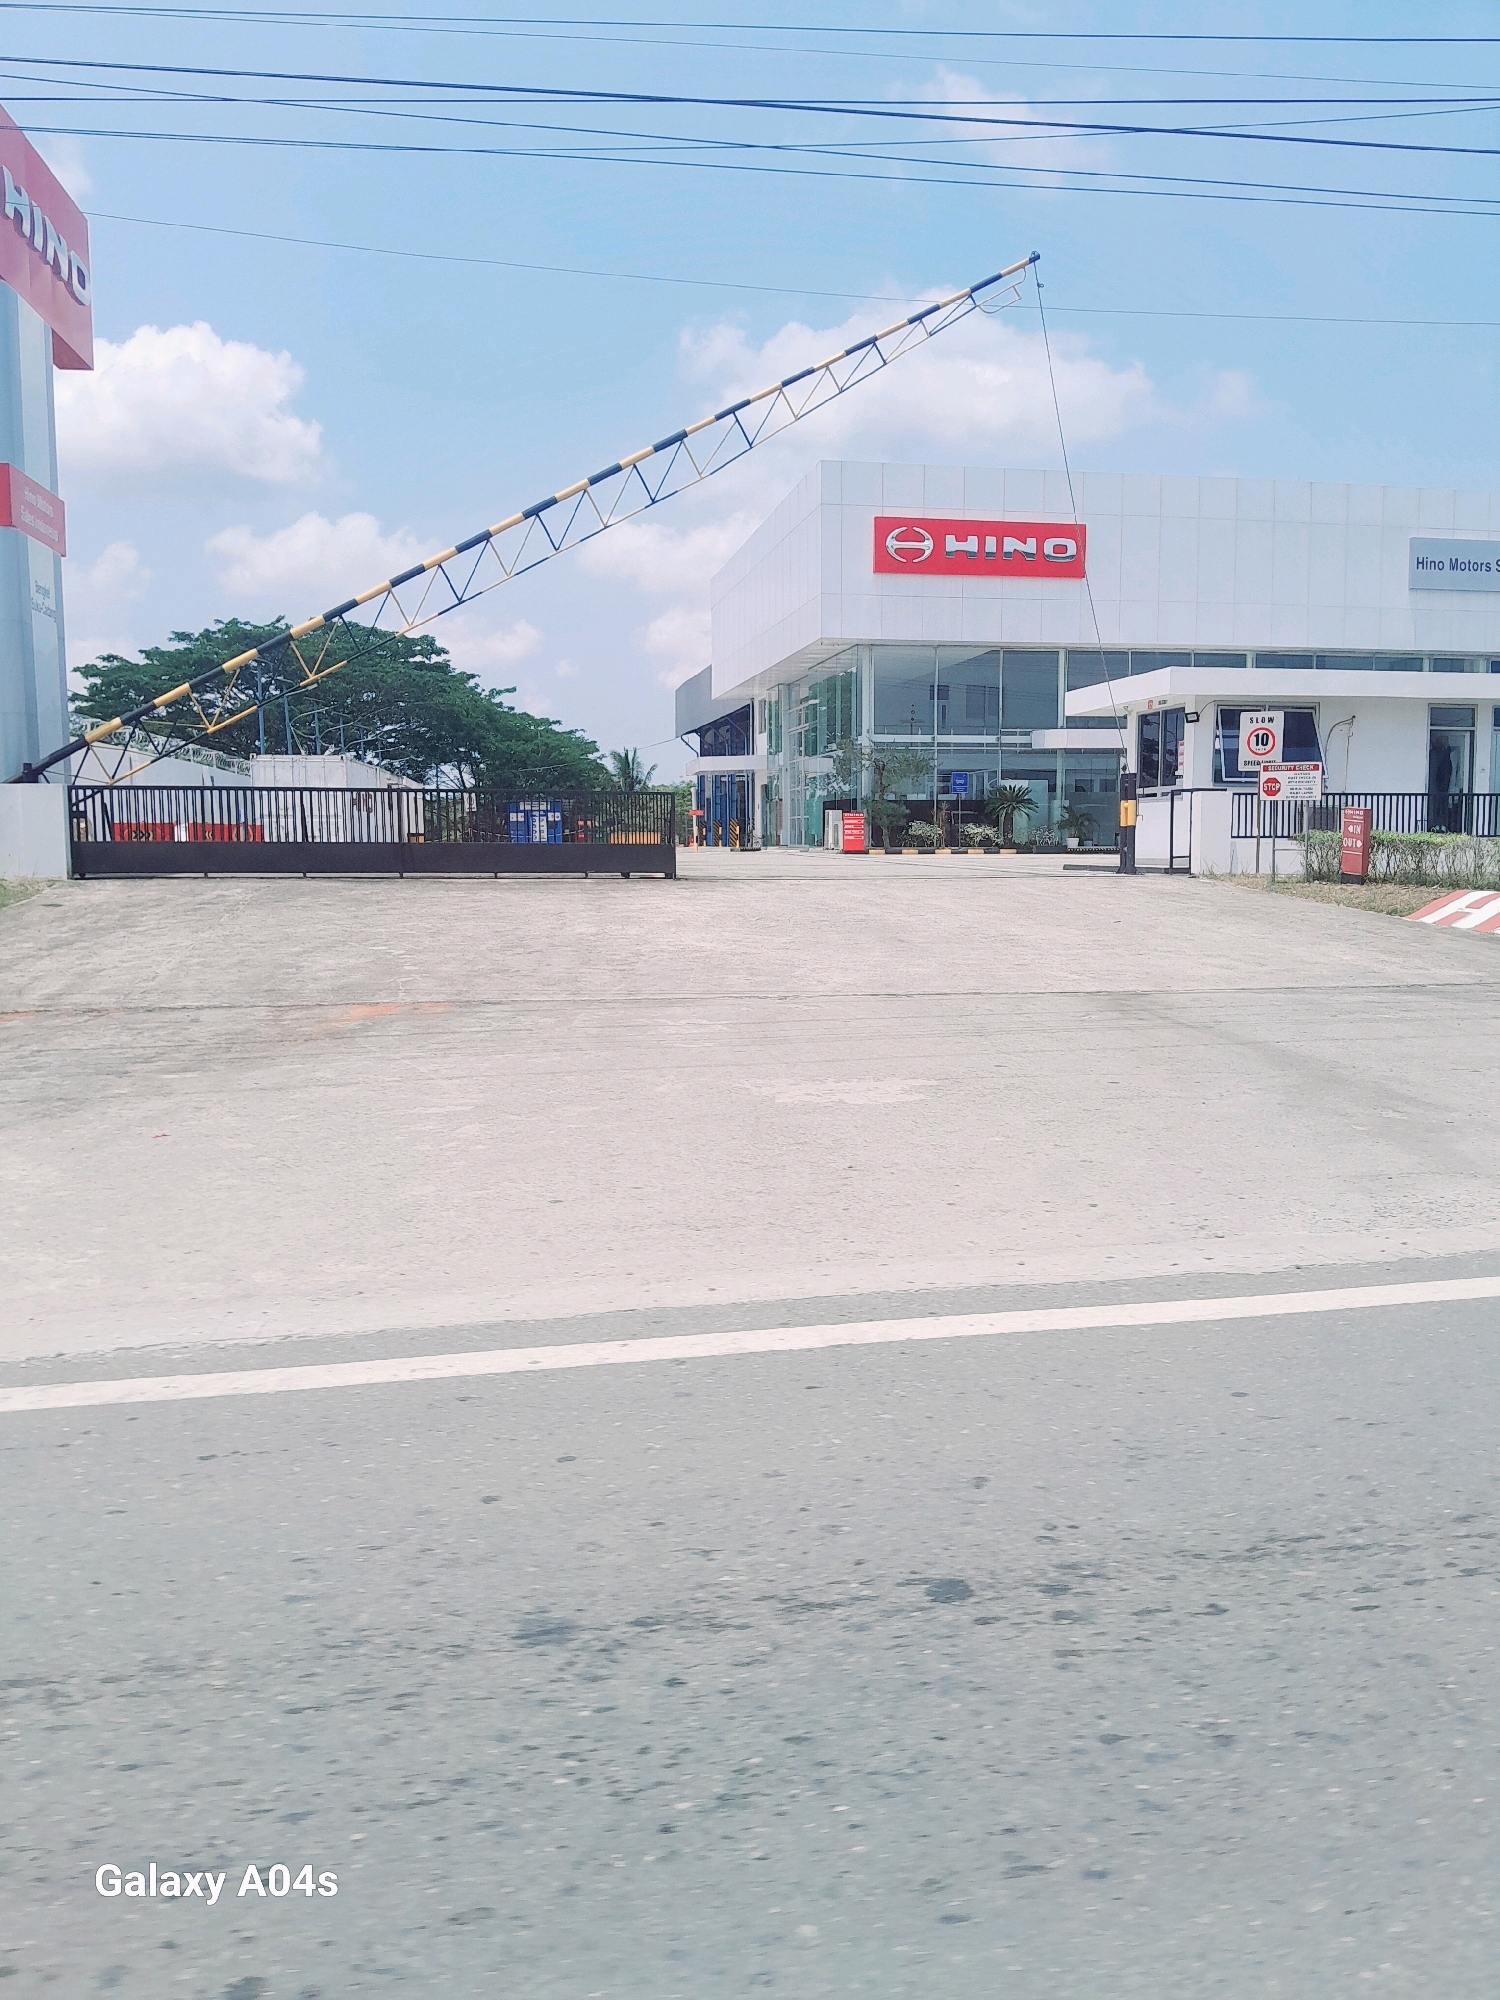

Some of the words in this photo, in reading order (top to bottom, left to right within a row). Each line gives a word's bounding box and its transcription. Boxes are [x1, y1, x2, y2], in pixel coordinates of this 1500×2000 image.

[1, 164, 90, 306] HINO
[944, 534, 1077, 562] HINO
[1416, 556, 1445, 571] Hino
[1449, 557, 1492, 572] Motors
[1249, 716, 1275, 724] SLOW
[1254, 732, 1270, 747] 10
[1263, 782, 1281, 791] STOP
[1353, 824, 1362, 835] IN
[1343, 837, 1357, 848] OUT
